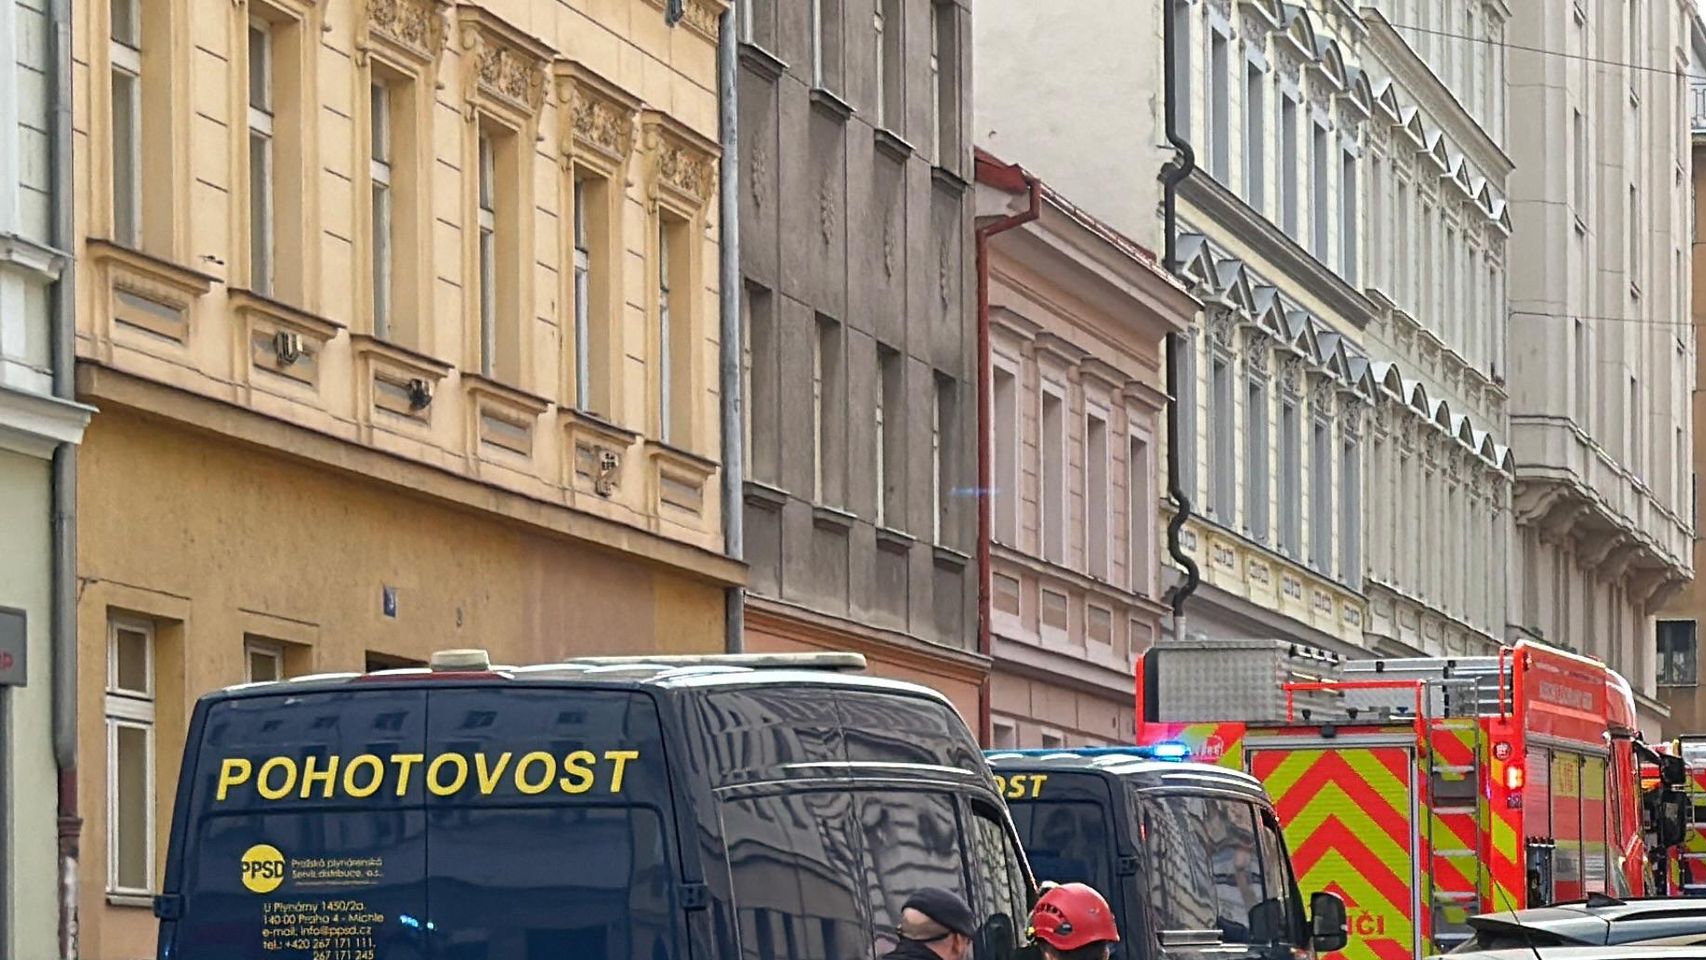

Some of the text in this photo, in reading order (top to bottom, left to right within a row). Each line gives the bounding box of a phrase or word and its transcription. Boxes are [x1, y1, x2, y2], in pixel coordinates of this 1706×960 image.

[216, 750, 639, 800] POHOTOVOST
[240, 860, 285, 879] PPSD
[299, 914, 329, 924] Praha
[301, 925, 371, 937] info@ppsd.cz
[313, 938, 330, 949] 267
[335, 938, 350, 948] 171
[313, 950, 374, 960] 267 171 245
